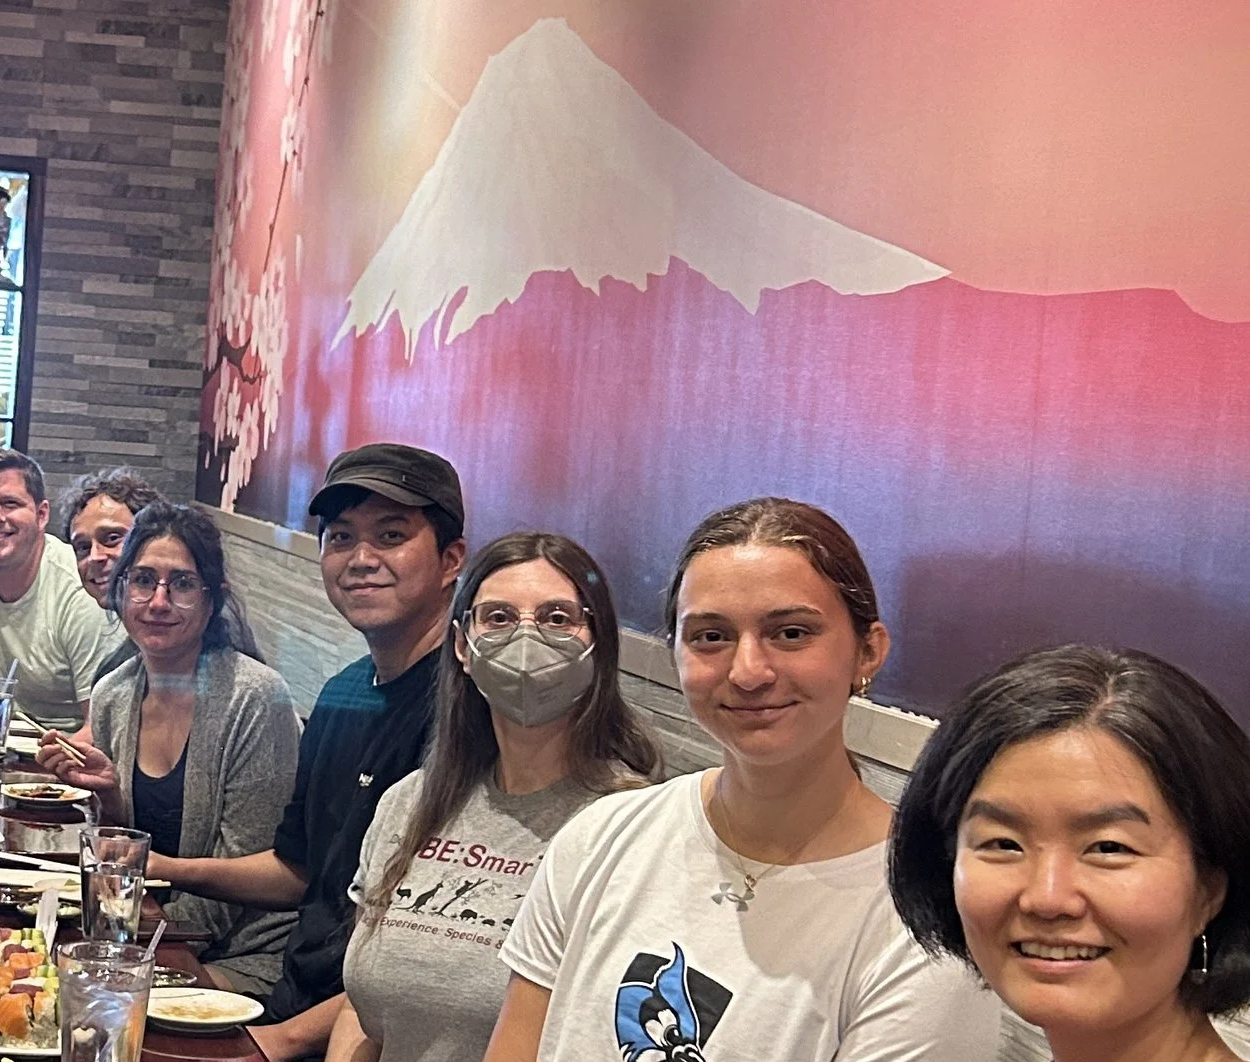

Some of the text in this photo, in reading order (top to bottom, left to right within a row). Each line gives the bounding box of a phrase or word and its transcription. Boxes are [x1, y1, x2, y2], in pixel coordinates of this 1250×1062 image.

[418, 837, 544, 876] BE:Smar
[380, 916, 439, 935] Experience
[444, 927, 492, 946] Species
